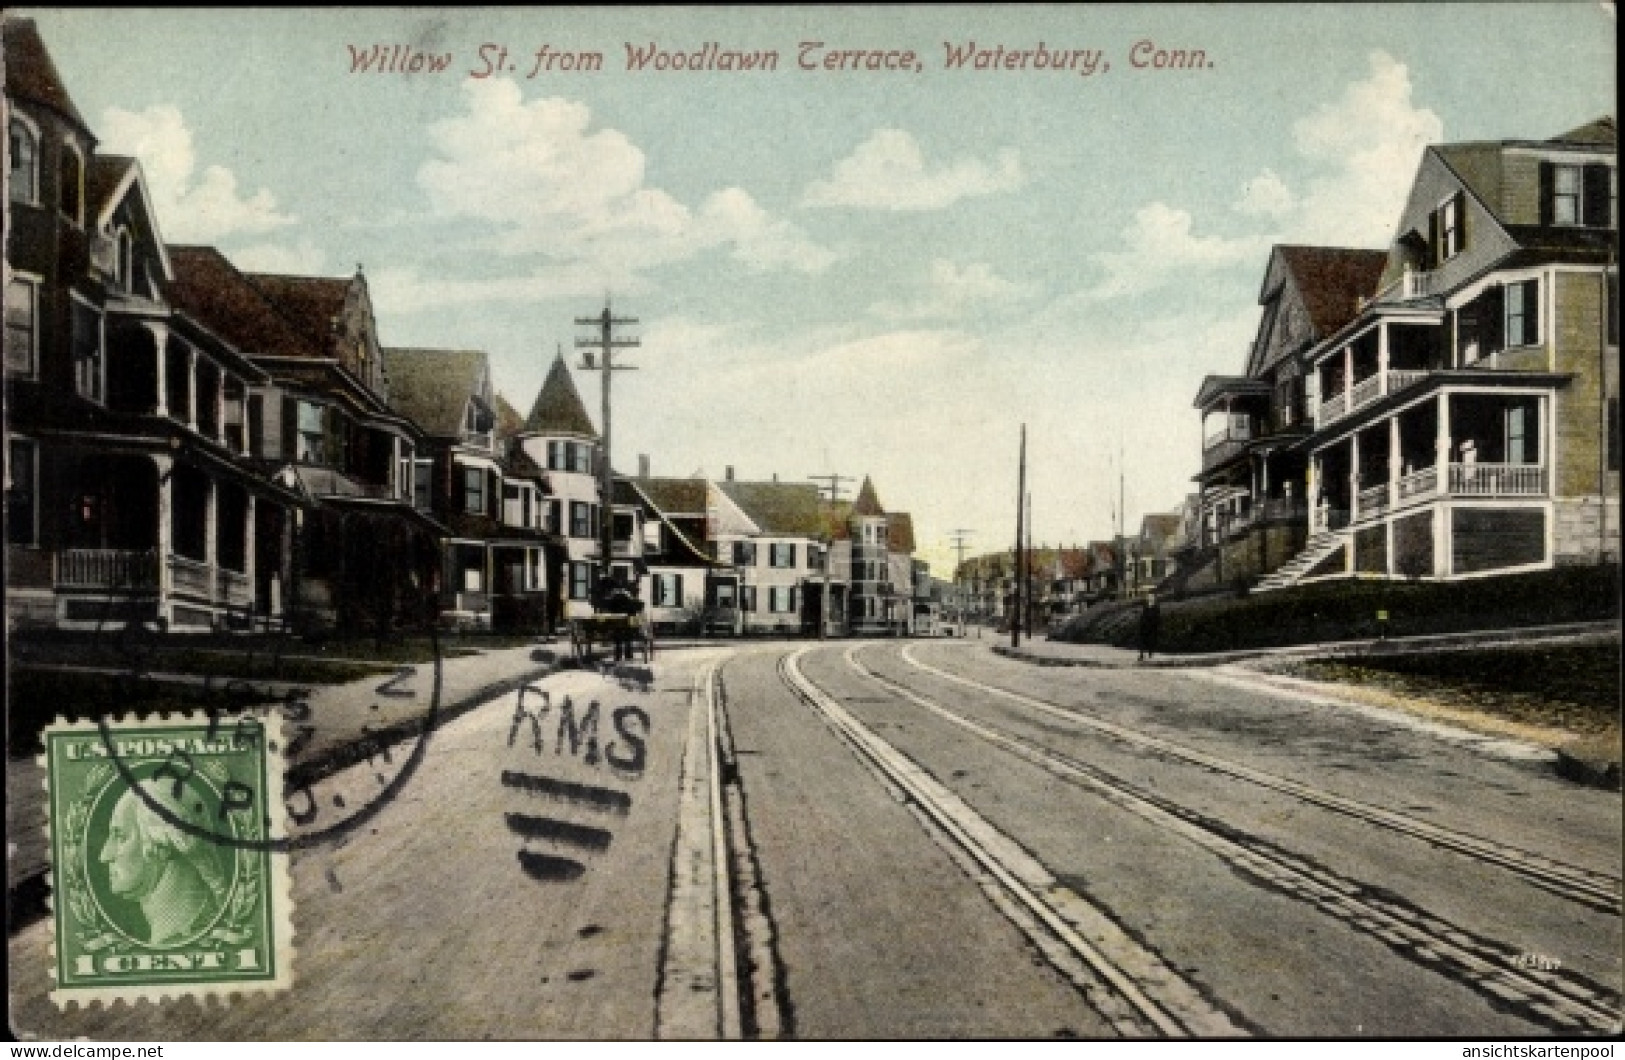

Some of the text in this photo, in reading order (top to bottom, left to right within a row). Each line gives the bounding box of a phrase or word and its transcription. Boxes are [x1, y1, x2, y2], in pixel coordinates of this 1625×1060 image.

[507, 685, 651, 781] RMS
[74, 948, 259, 976] 1 CENT 1
